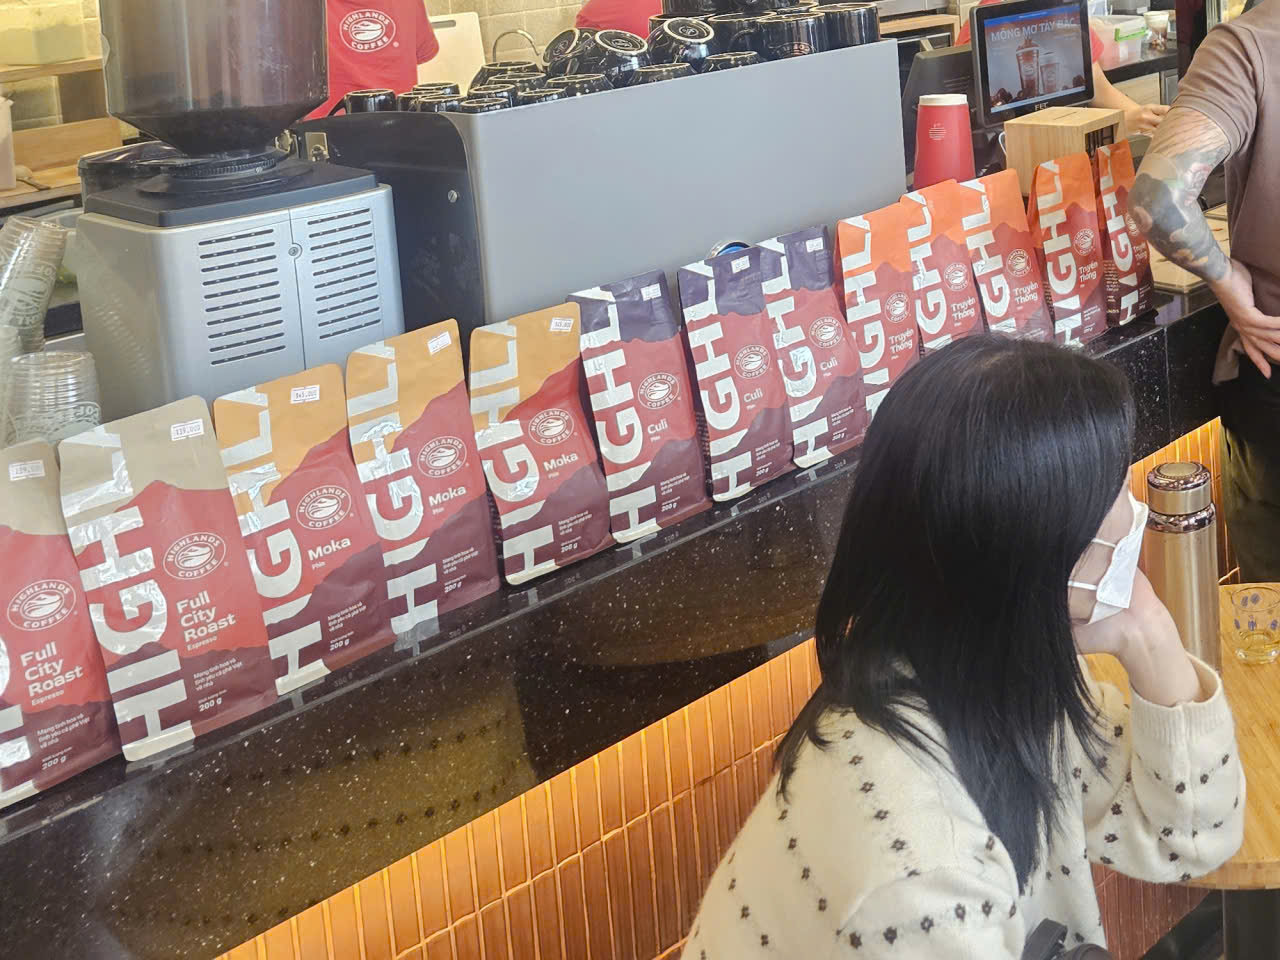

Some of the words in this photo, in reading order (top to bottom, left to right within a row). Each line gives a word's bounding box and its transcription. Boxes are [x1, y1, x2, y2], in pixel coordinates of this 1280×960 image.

[342, 11, 391, 32] HIGHLANDS
[351, 36, 389, 50] COFFEE
[820, 356, 838, 371] Culi
[743, 388, 763, 403] Culi
[530, 409, 569, 431] HIGHLANDS
[647, 418, 668, 435] Culi
[540, 429, 570, 445] COFFEE
[420, 438, 463, 462] HIGHLANDS
[428, 459, 462, 476] COFFEE
[543, 452, 579, 472] Moka
[298, 487, 347, 513] HIGHLANDS
[428, 486, 467, 507] Moka
[308, 510, 345, 528] COFFEE
[166, 534, 221, 562] HIGHLANDS
[307, 538, 351, 561] Moka
[178, 558, 218, 578] COFFEE
[12, 581, 70, 612] HIGHLANDS
[176, 590, 210, 613] Full
[23, 607, 69, 629] COFFEE
[180, 606, 217, 628] City
[184, 613, 236, 642] Roast
[20, 640, 57, 667] Full
[187, 636, 217, 651] Espresso
[24, 658, 64, 682] City
[28, 665, 84, 697] Roast
[32, 690, 64, 706] Espresso
[199, 700, 215, 712] 200
